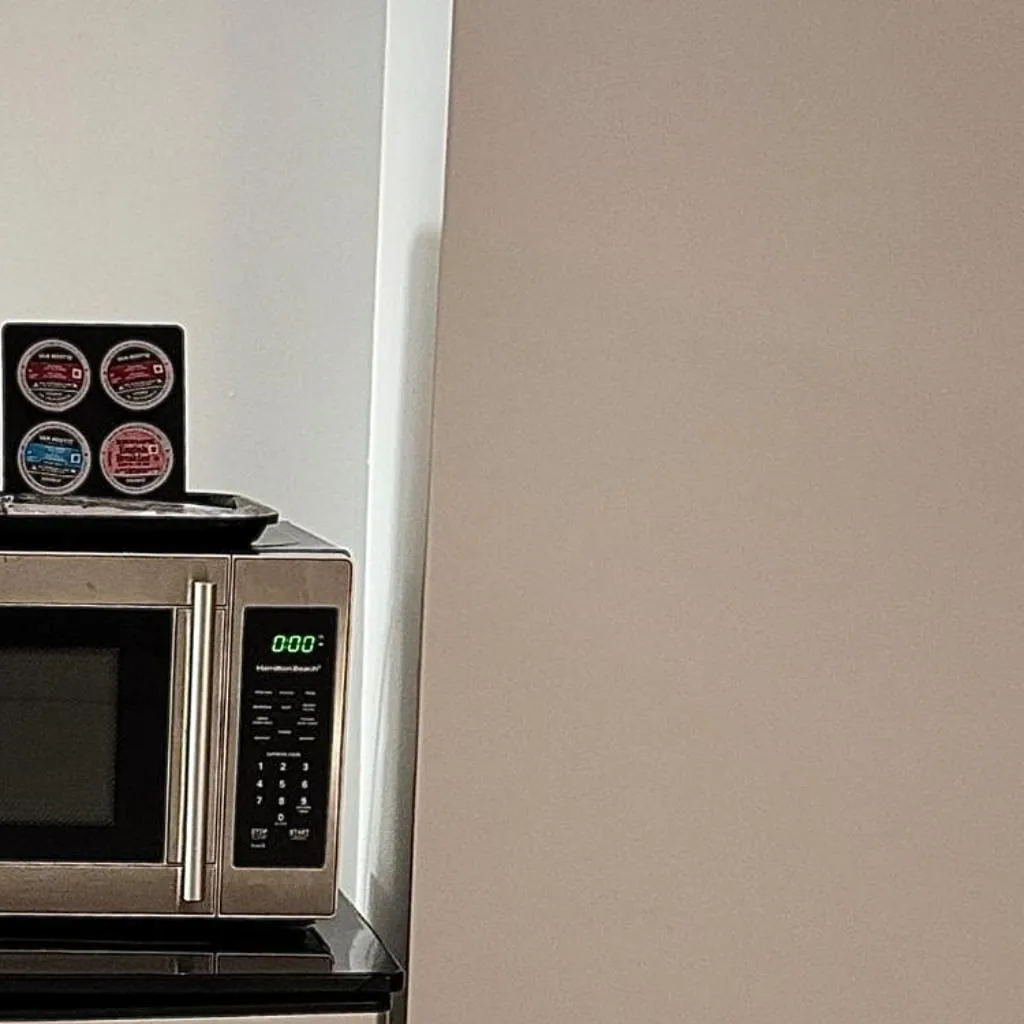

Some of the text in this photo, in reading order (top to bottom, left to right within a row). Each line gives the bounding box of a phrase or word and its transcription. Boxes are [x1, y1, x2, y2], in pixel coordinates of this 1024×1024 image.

[271, 634, 316, 654] 0:00
[257, 761, 264, 771] 1
[279, 761, 287, 771] 2
[302, 762, 309, 771] 3
[256, 779, 264, 788] 4
[301, 780, 308, 789] 6
[256, 795, 263, 805] 7
